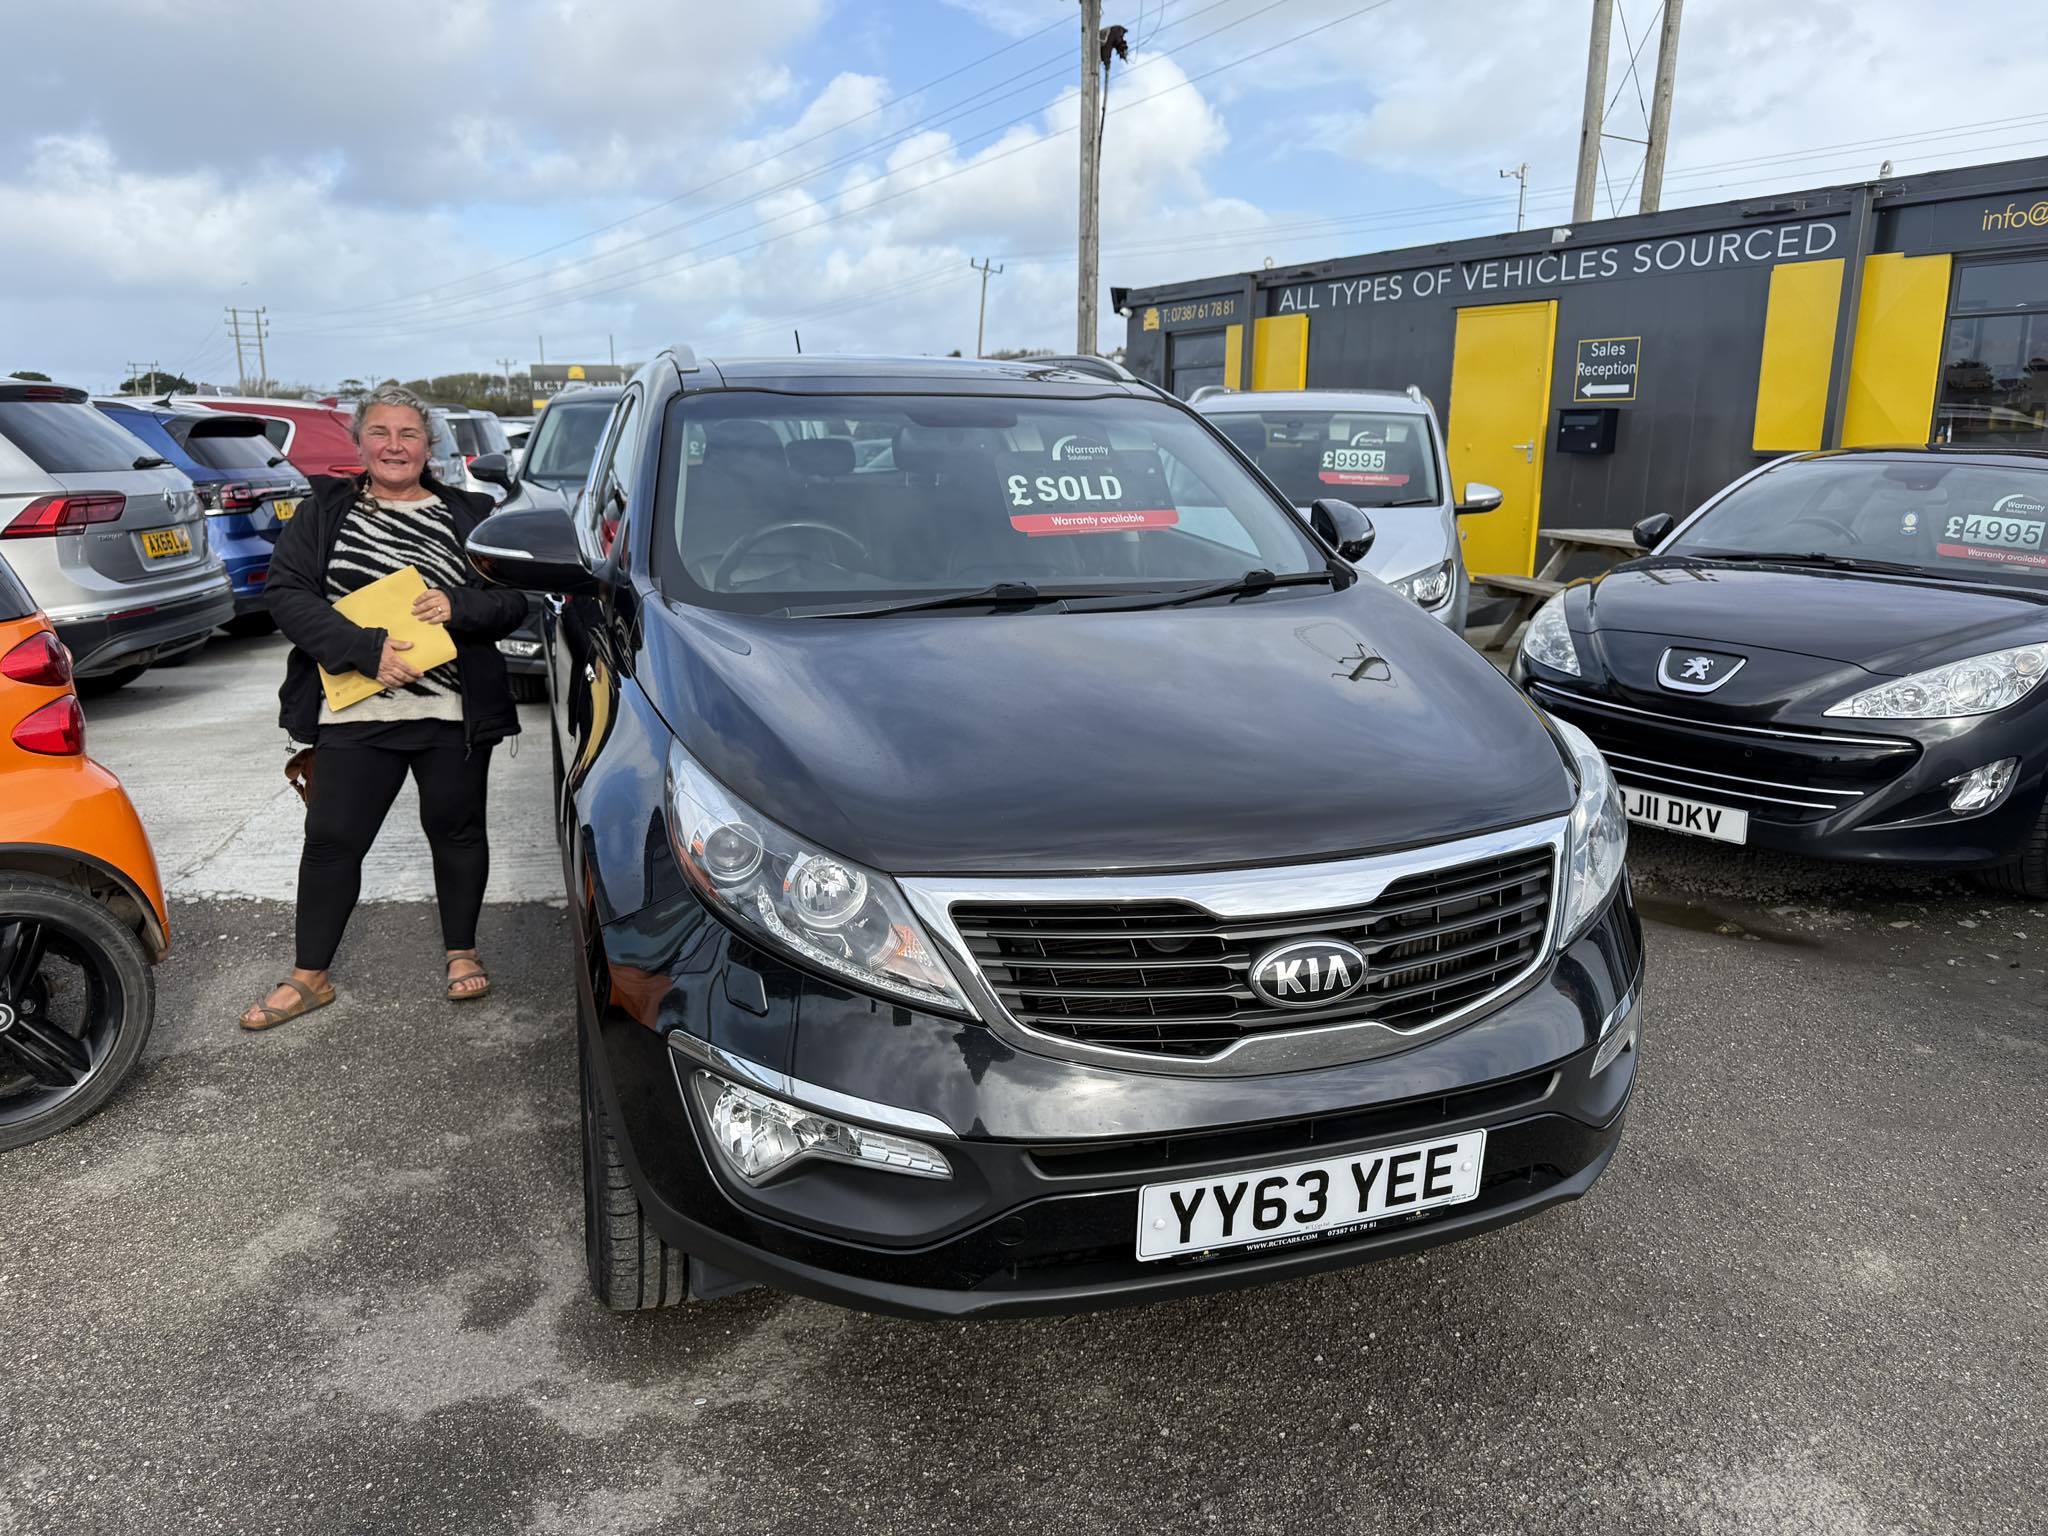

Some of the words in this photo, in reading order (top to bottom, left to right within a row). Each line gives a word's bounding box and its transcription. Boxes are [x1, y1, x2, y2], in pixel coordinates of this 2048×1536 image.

[1982, 201, 2048, 231] info@
[1279, 287, 1320, 312] ALL
[1328, 275, 1402, 307] TYPES
[1412, 268, 1452, 297] OF
[1462, 247, 1618, 291] VEHICLES
[1633, 222, 1837, 273] SOURCED
[1590, 341, 1626, 357] Sales
[1577, 361, 1637, 380] Reception
[1064, 444, 1110, 455] Warranty
[2007, 501, 2045, 513] Warranty
[1051, 515, 1098, 527] Warranty
[1100, 513, 1145, 524] available
[1967, 548, 2006, 561] Warranty
[2007, 554, 2047, 565] available
[1667, 800, 1722, 833] DKV
[1274, 954, 1352, 996] KIA
[1169, 1169, 1330, 1245] YY63
[1350, 1143, 1459, 1214] YEE
[1246, 1232, 1319, 1252] WWW.RCTCARS.COM
[1327, 1227, 1348, 1237] 07387
